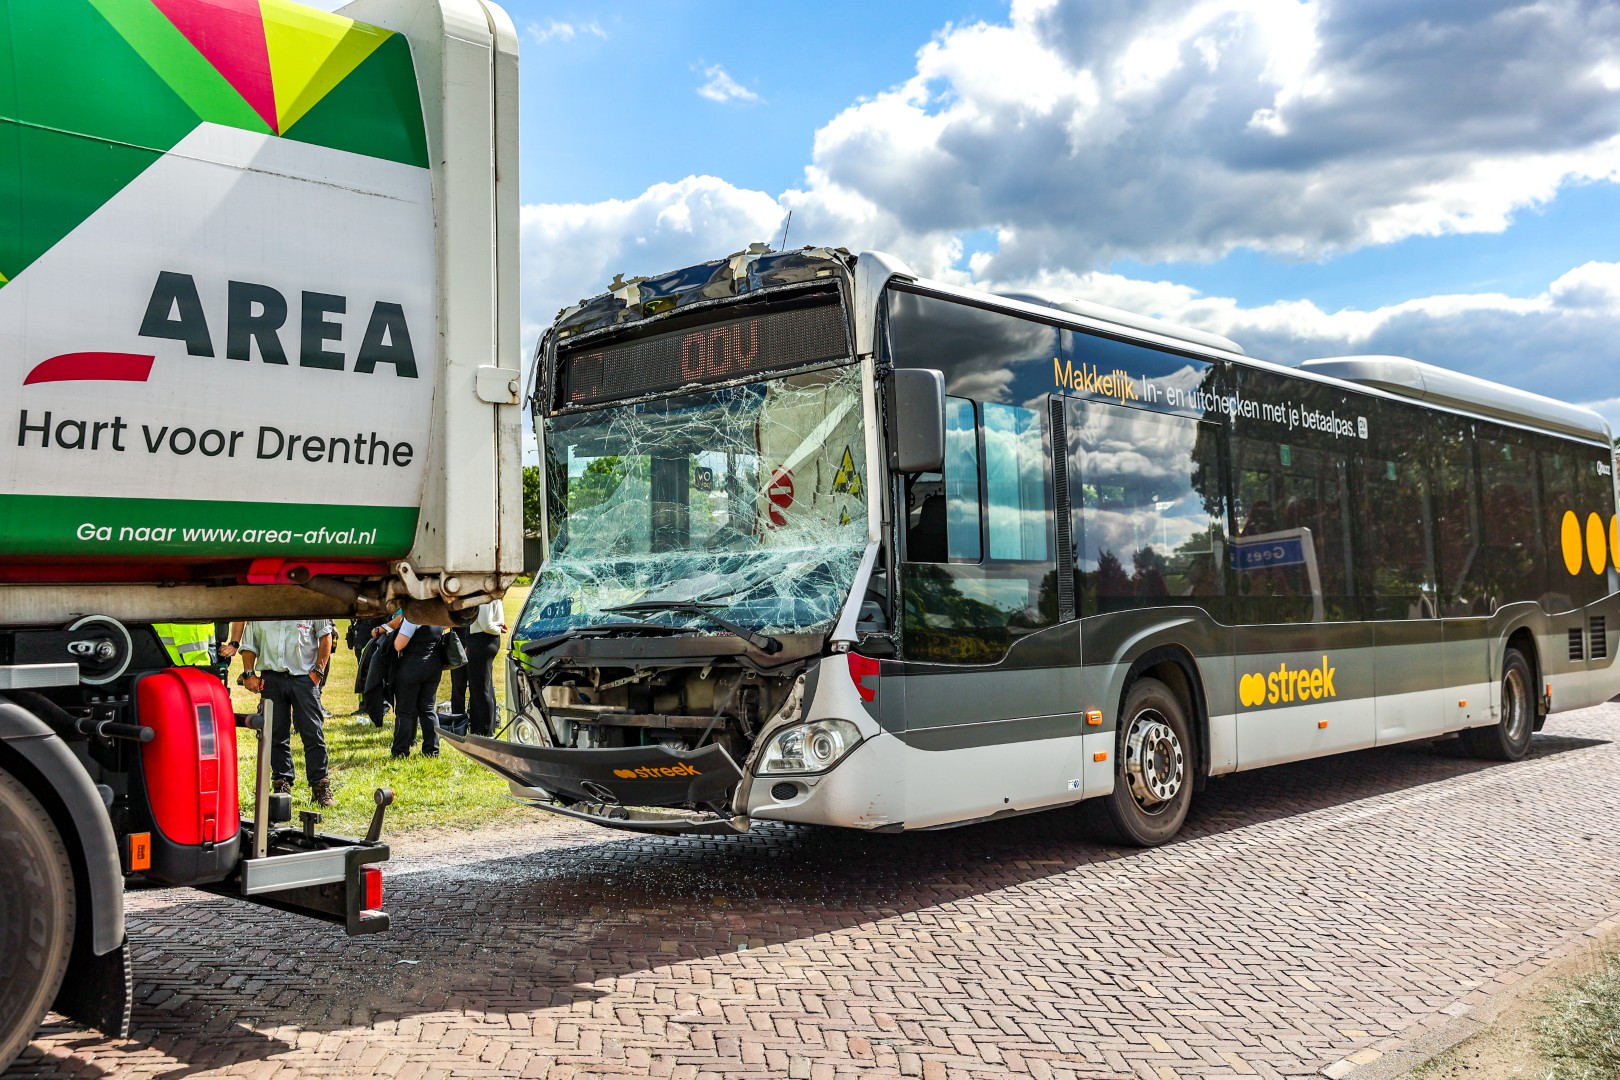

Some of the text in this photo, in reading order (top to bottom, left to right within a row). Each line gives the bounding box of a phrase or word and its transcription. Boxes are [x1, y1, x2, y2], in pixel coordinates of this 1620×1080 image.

[138, 270, 419, 379] AREA
[1053, 357, 1356, 438] Makkelijk. In- en uitchecken met je betaalpas.
[17, 409, 414, 467] Hart voor Drenthe
[76, 523, 377, 545] Ga naar www.area-afval.nl
[1267, 655, 1336, 704] streek
[634, 761, 702, 778] streek
